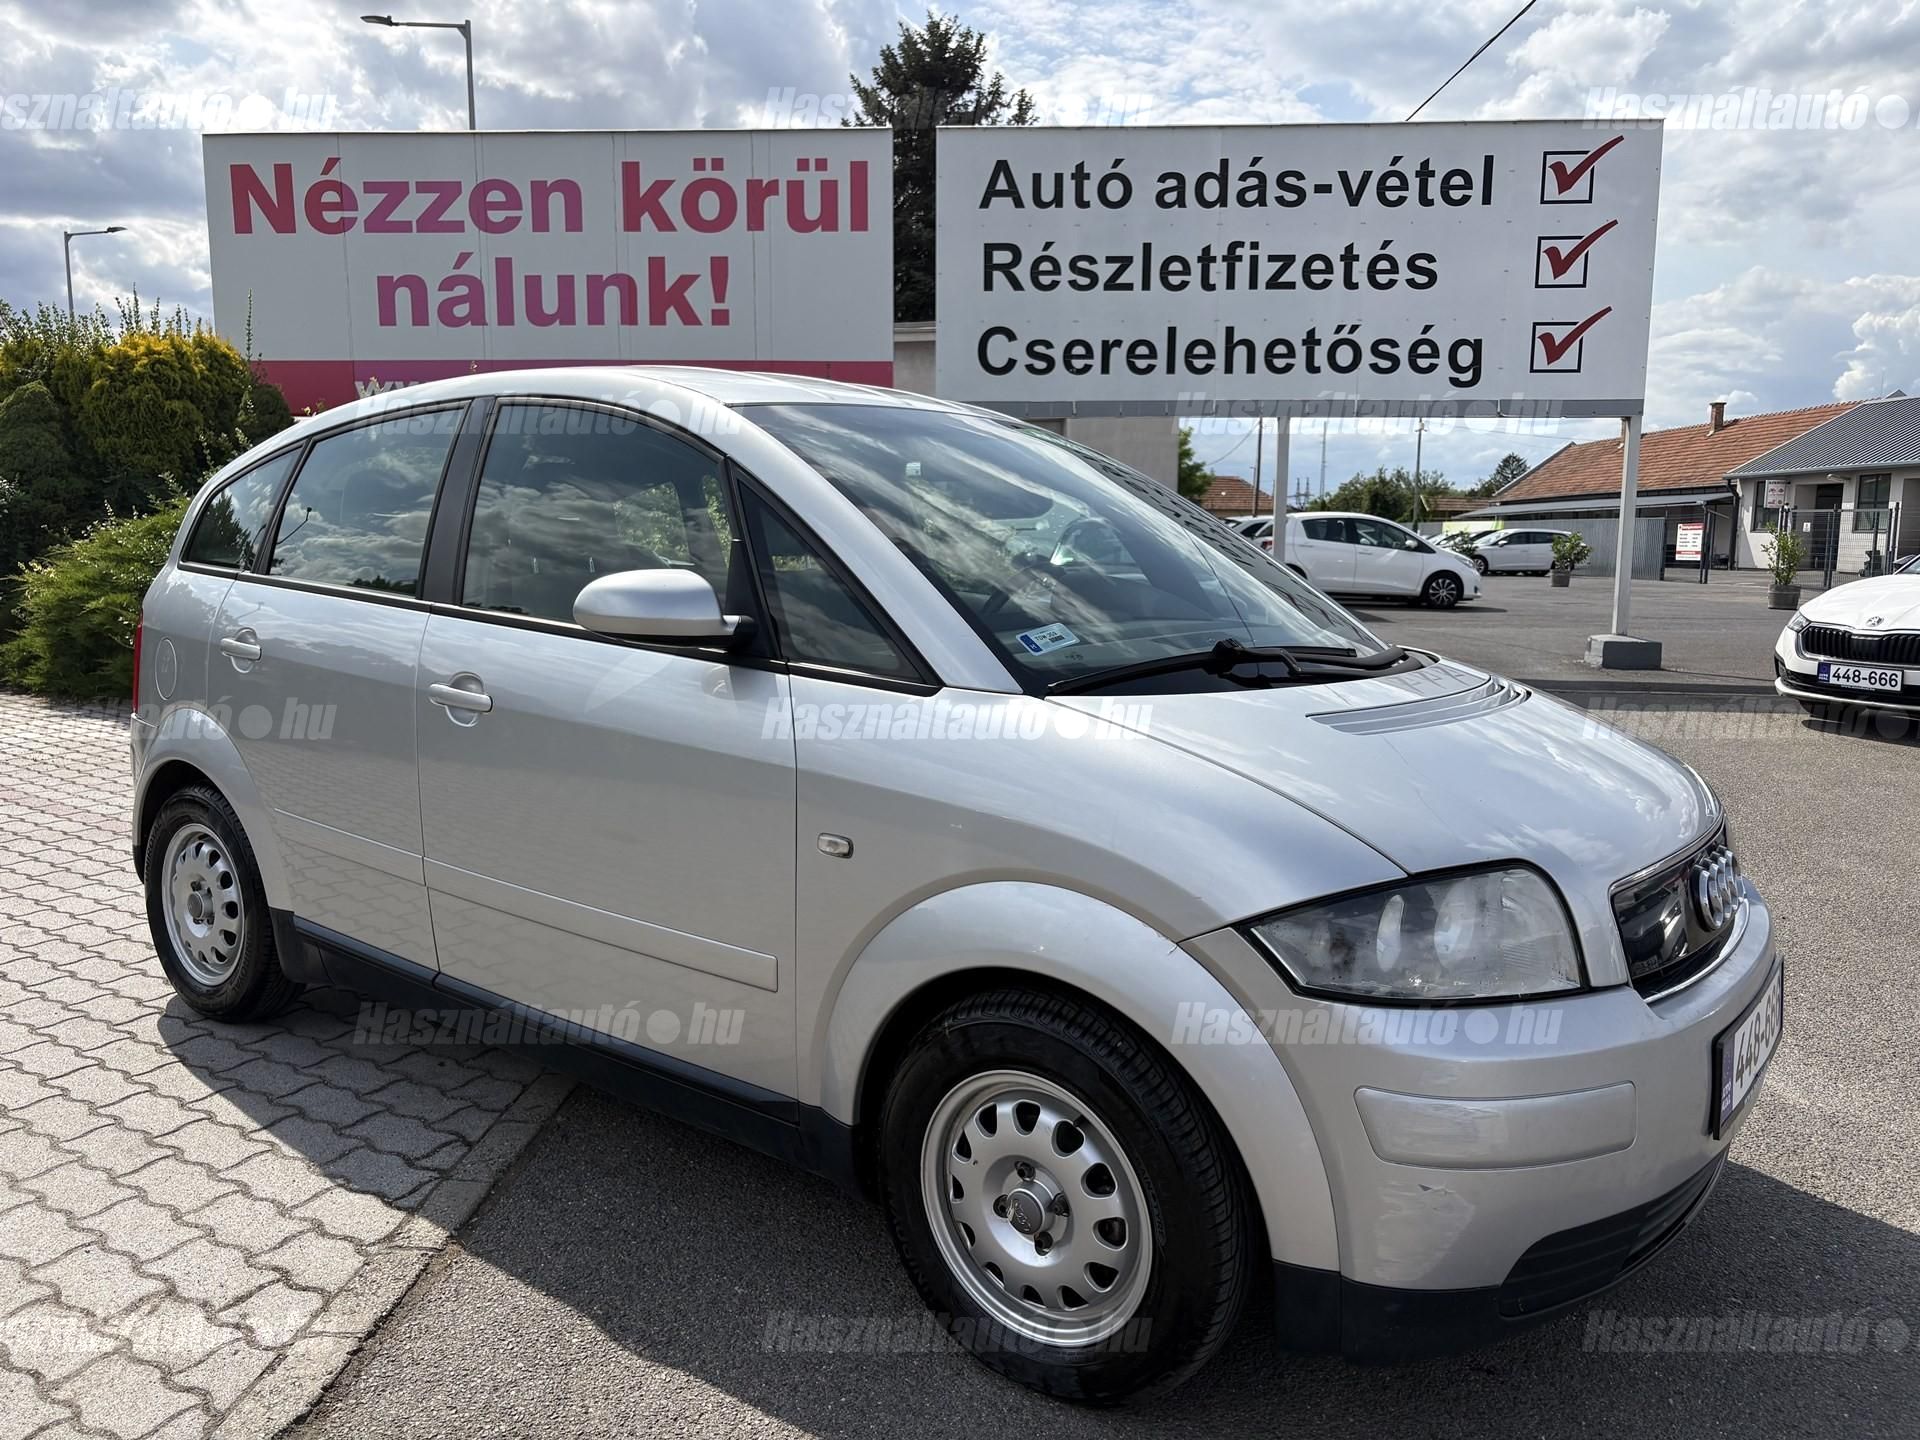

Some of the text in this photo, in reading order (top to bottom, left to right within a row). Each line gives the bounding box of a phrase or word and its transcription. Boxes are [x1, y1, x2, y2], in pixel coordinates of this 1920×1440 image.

[231, 158, 867, 234] Nézzen körül
[979, 155, 1494, 209] Autó adás-vétel
[379, 256, 728, 326] nálunk!
[984, 240, 1437, 292] Részletfizetés
[978, 325, 1482, 389] Cserelehetőség
[1832, 667, 1898, 688] 448-666
